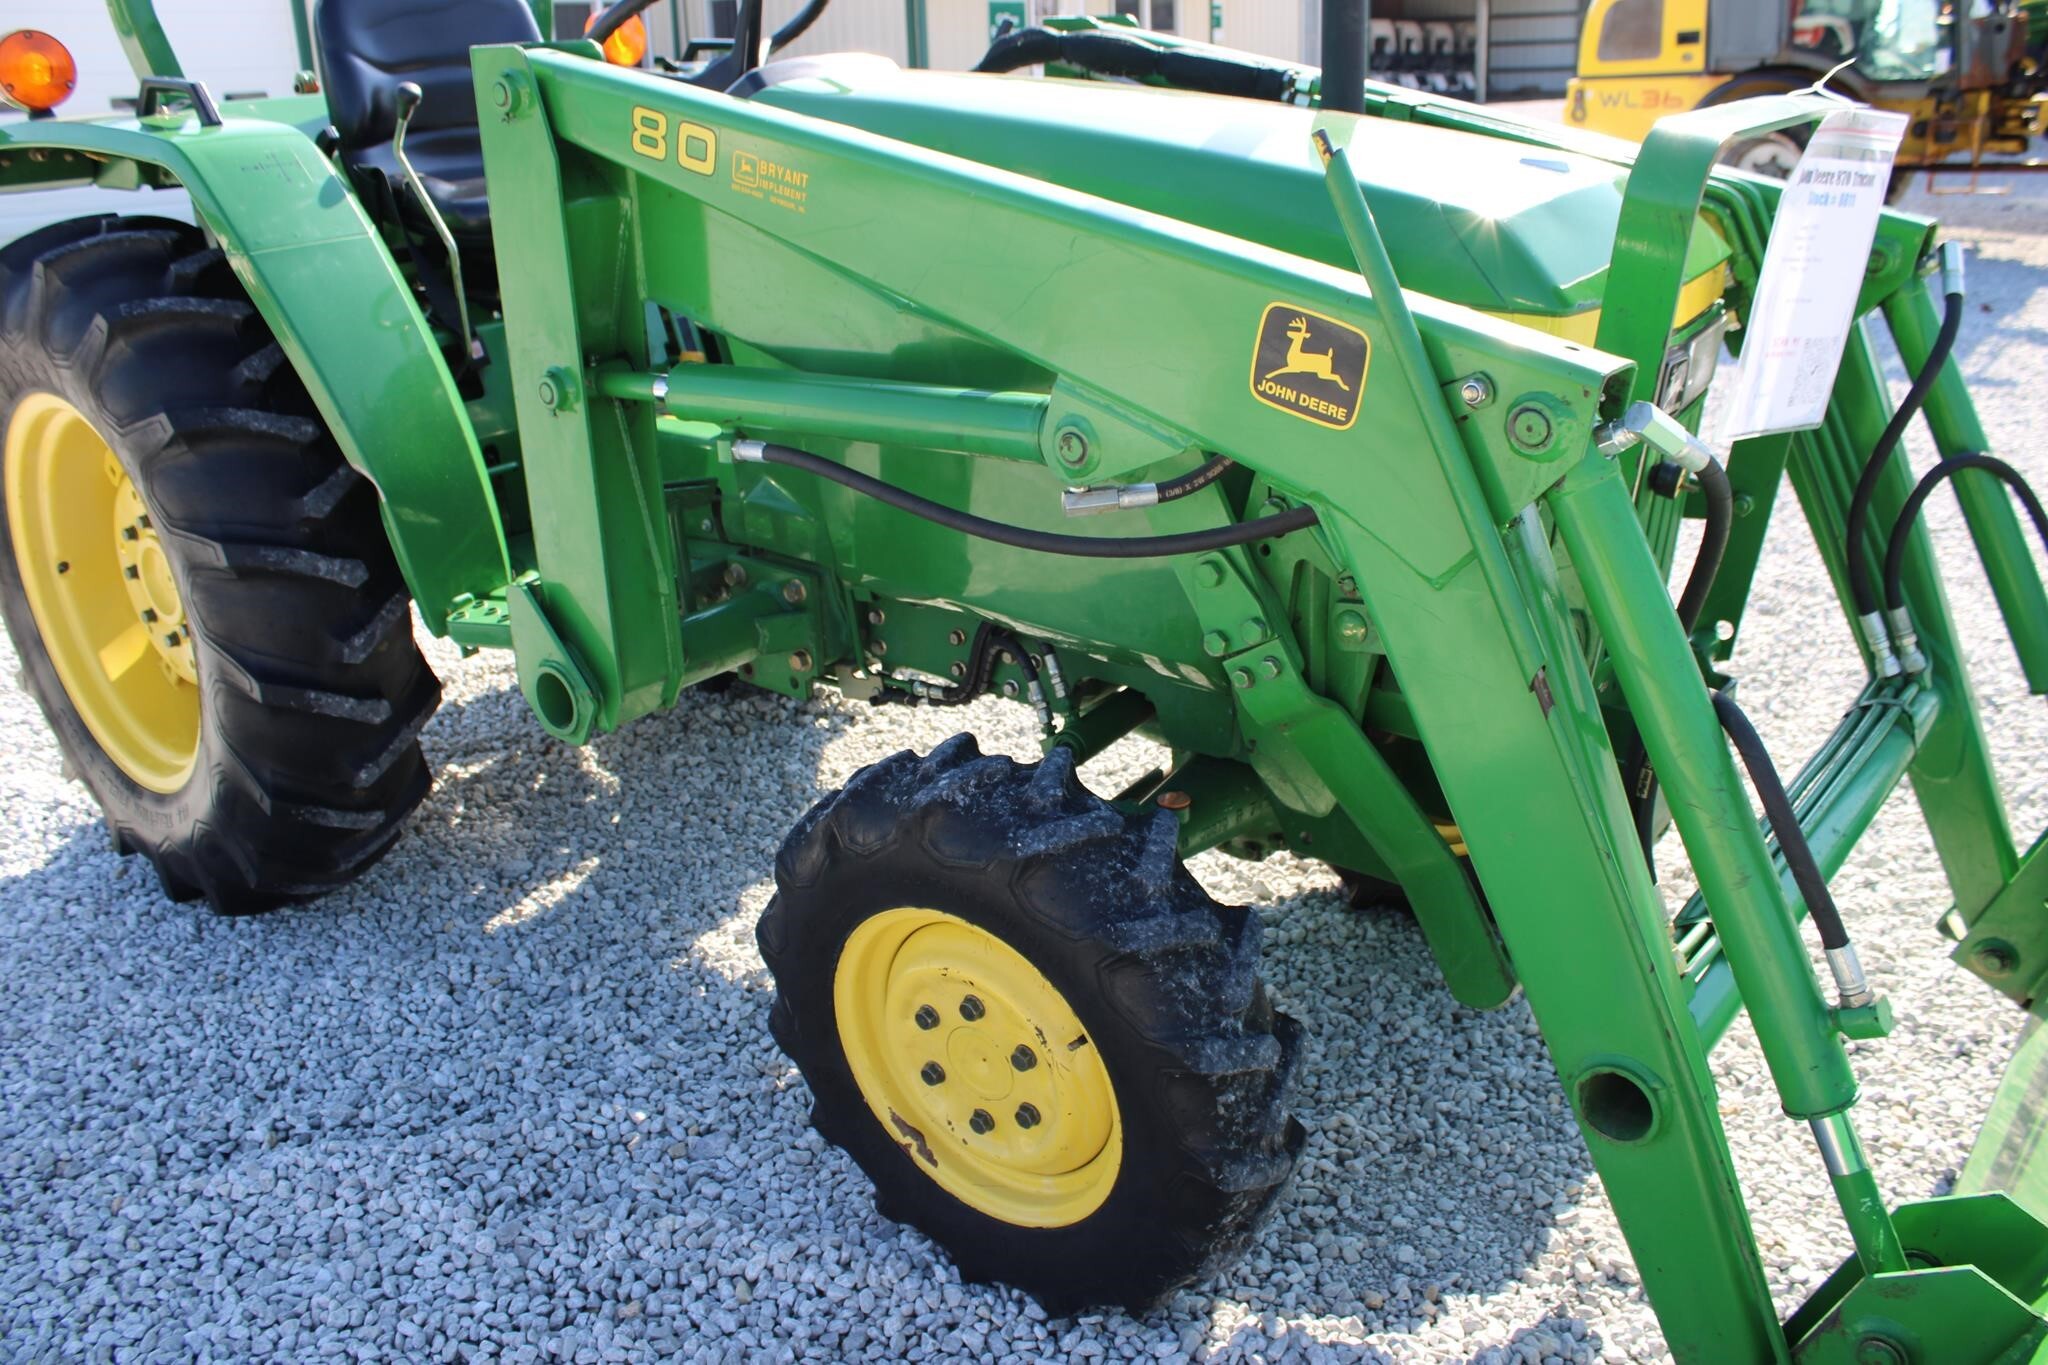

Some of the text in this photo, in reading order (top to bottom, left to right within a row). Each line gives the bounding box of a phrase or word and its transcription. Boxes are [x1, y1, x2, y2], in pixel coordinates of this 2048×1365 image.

[632, 105, 717, 177] 80
[759, 178, 807, 202] IMPLEMENT
[760, 159, 808, 189] BRYANT
[1257, 379, 1348, 421] JOHN DEERE
